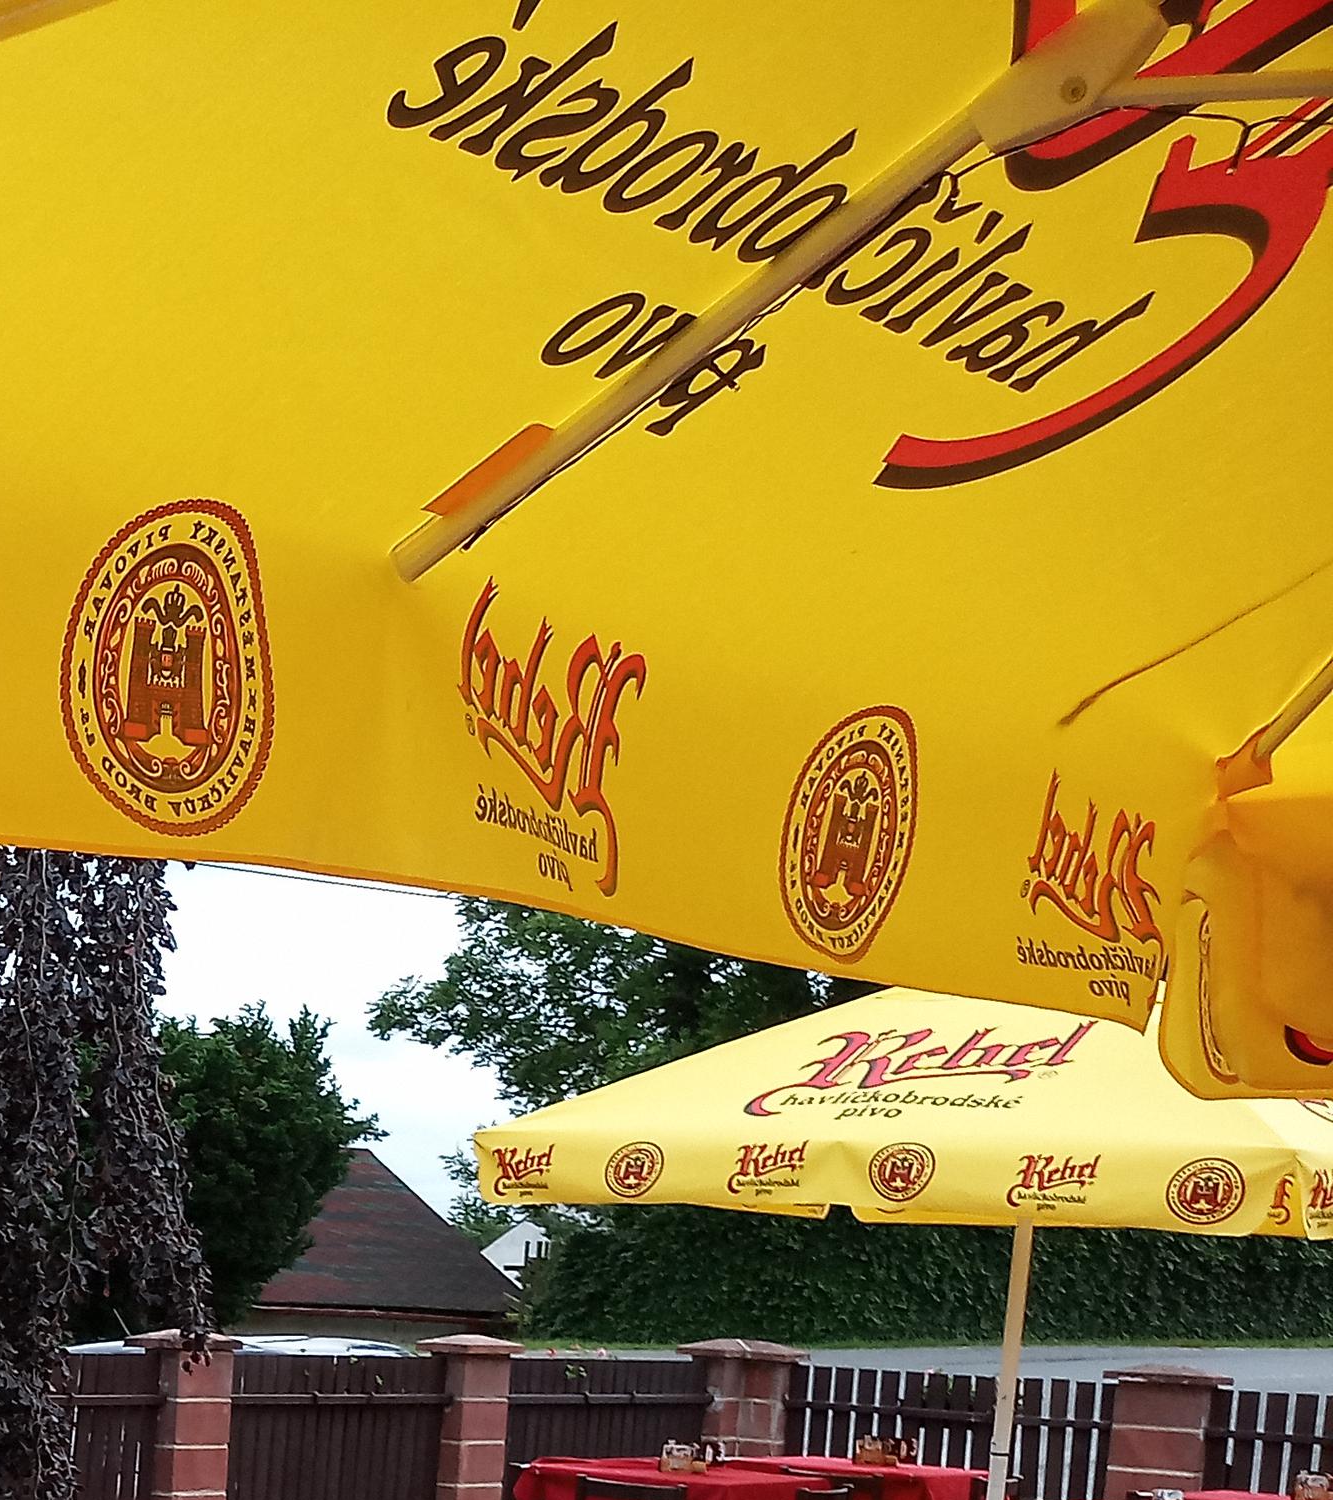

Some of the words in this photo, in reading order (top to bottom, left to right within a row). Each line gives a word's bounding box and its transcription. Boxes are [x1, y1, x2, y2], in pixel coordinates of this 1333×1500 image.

[743, 1020, 1099, 1117] Rebel
[780, 1089, 1023, 1110] havlíčkobrodské
[834, 1103, 903, 1120] pivo
